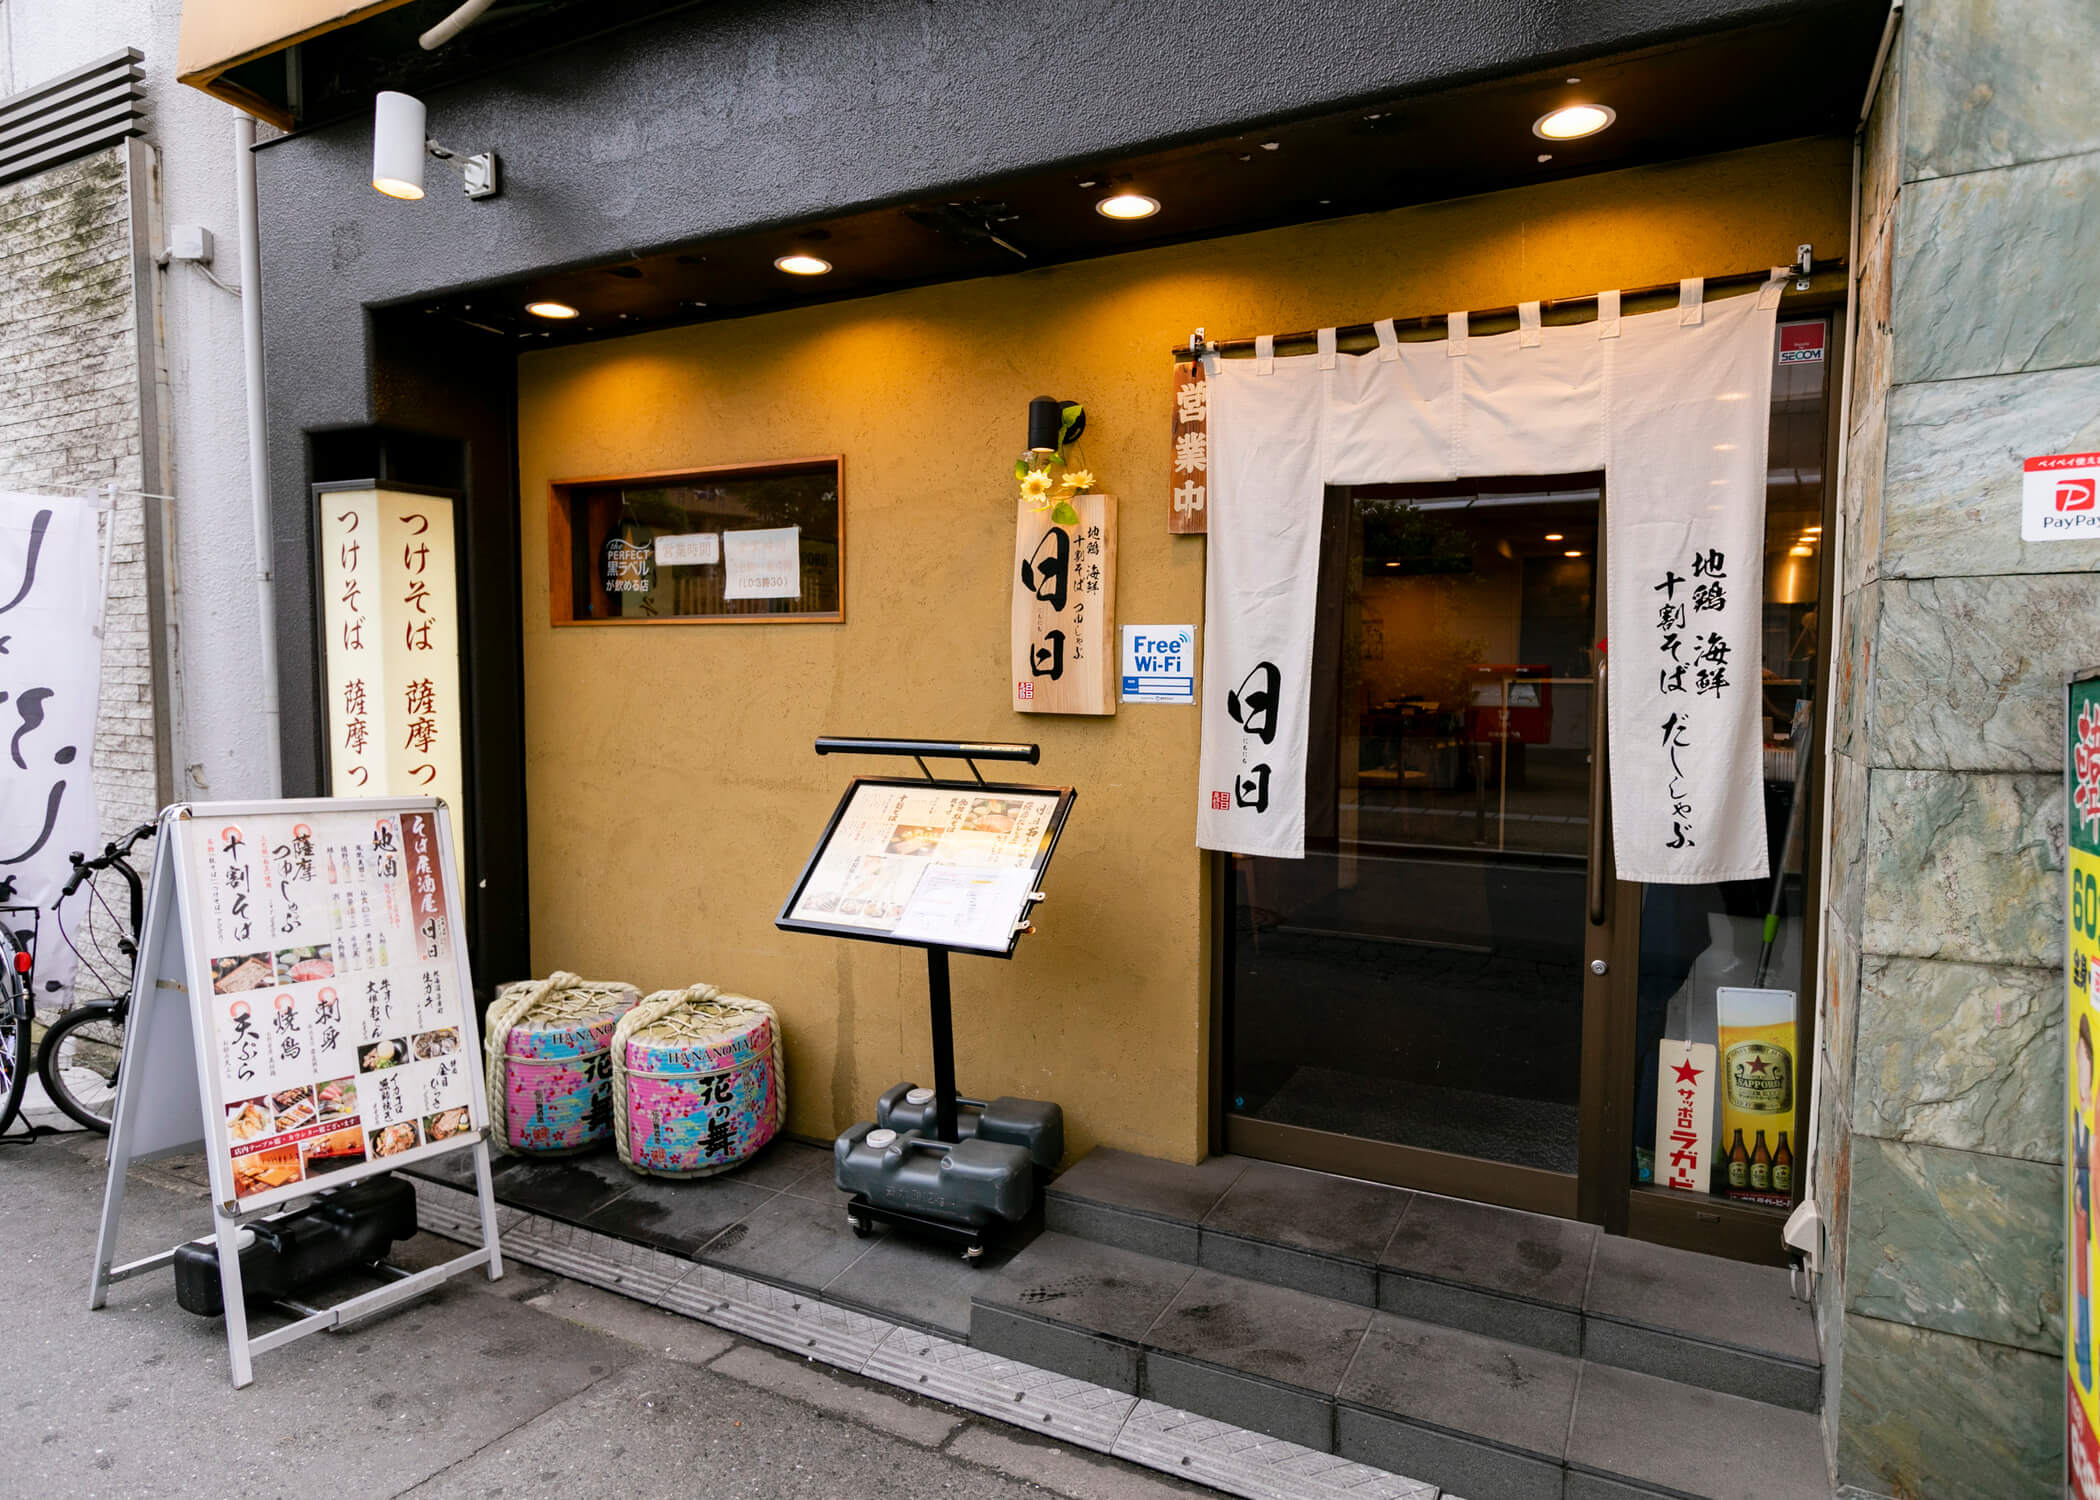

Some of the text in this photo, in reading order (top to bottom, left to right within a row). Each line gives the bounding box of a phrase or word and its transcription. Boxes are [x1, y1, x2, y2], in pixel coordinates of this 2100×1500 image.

[1781, 350, 1821, 361] SECOM
[1173, 380, 1207, 520] 営業中
[607, 549, 651, 561] PERFECT
[607, 560, 650, 576] 黒ラベル
[662, 543, 712, 559] 営業時間
[1086, 526, 1101, 596] 地鶏 海鮮
[606, 580, 649, 593] が飲める店
[1073, 534, 1085, 660] 十割そば つゆしゃぶ
[1134, 636, 1181, 653] Free
[1692, 548, 1732, 699] 地鶏 海鮮
[337, 510, 371, 798] つけそば 薩摩つ
[398, 511, 438, 798] つけそば 薩摩つ
[1134, 656, 1181, 672] Wi-Fi
[1654, 571, 1695, 849] 十割そば だししゃぶ
[292, 833, 318, 882] 薩摩
[372, 826, 398, 878] 地酒
[412, 815, 439, 913] そば居酒屋
[223, 835, 252, 942] 十割そば
[272, 845, 302, 934] つゆしゃぶ
[315, 997, 342, 1053] 刺身
[379, 977, 393, 1020] 牛すじ
[273, 1006, 301, 1060] 焼鳥
[552, 1024, 616, 1045] HANANO
[667, 1037, 755, 1064] HANANOMAI
[1738, 1079, 1781, 1089] SAPPORO
[697, 1073, 738, 1158] 花の舞
